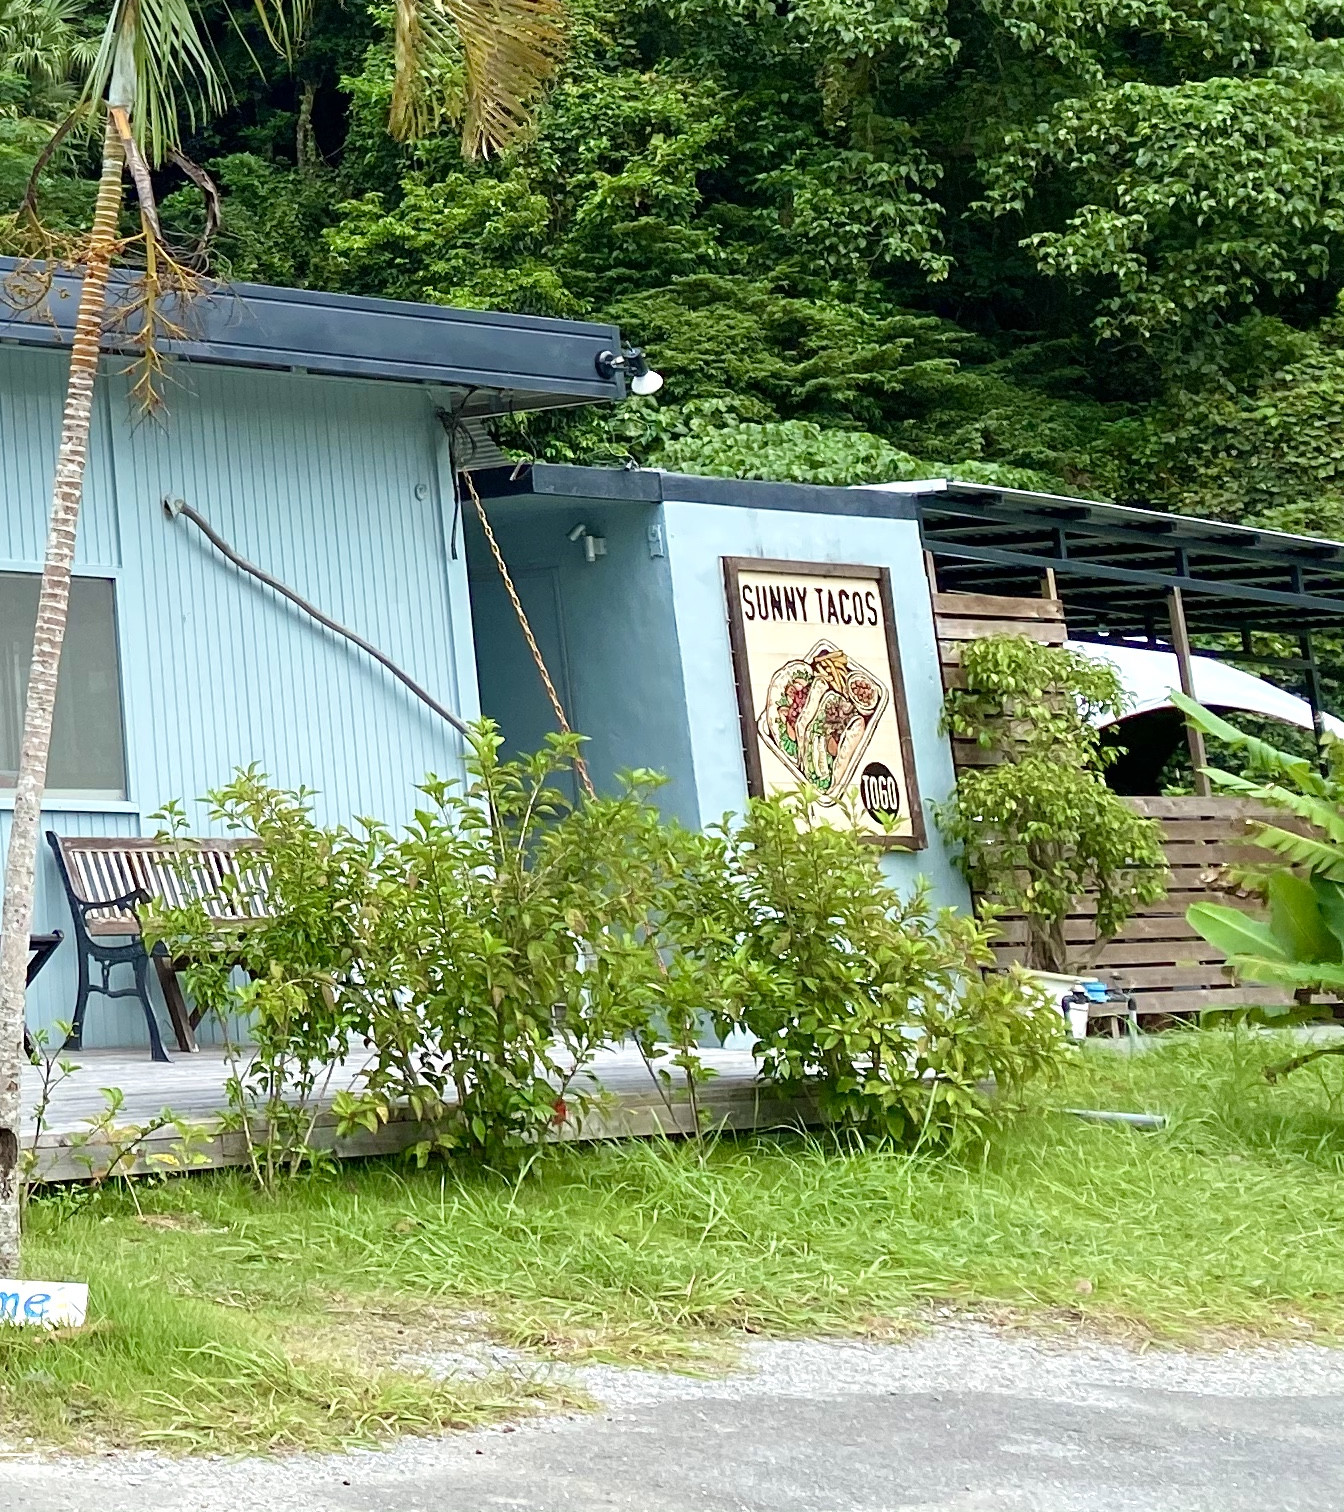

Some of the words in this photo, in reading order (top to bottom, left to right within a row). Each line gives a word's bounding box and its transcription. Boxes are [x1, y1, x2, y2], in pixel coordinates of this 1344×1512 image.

[742, 584, 807, 621] SUNNY
[814, 588, 877, 626] TACOS
[861, 774, 898, 810] TOGO
